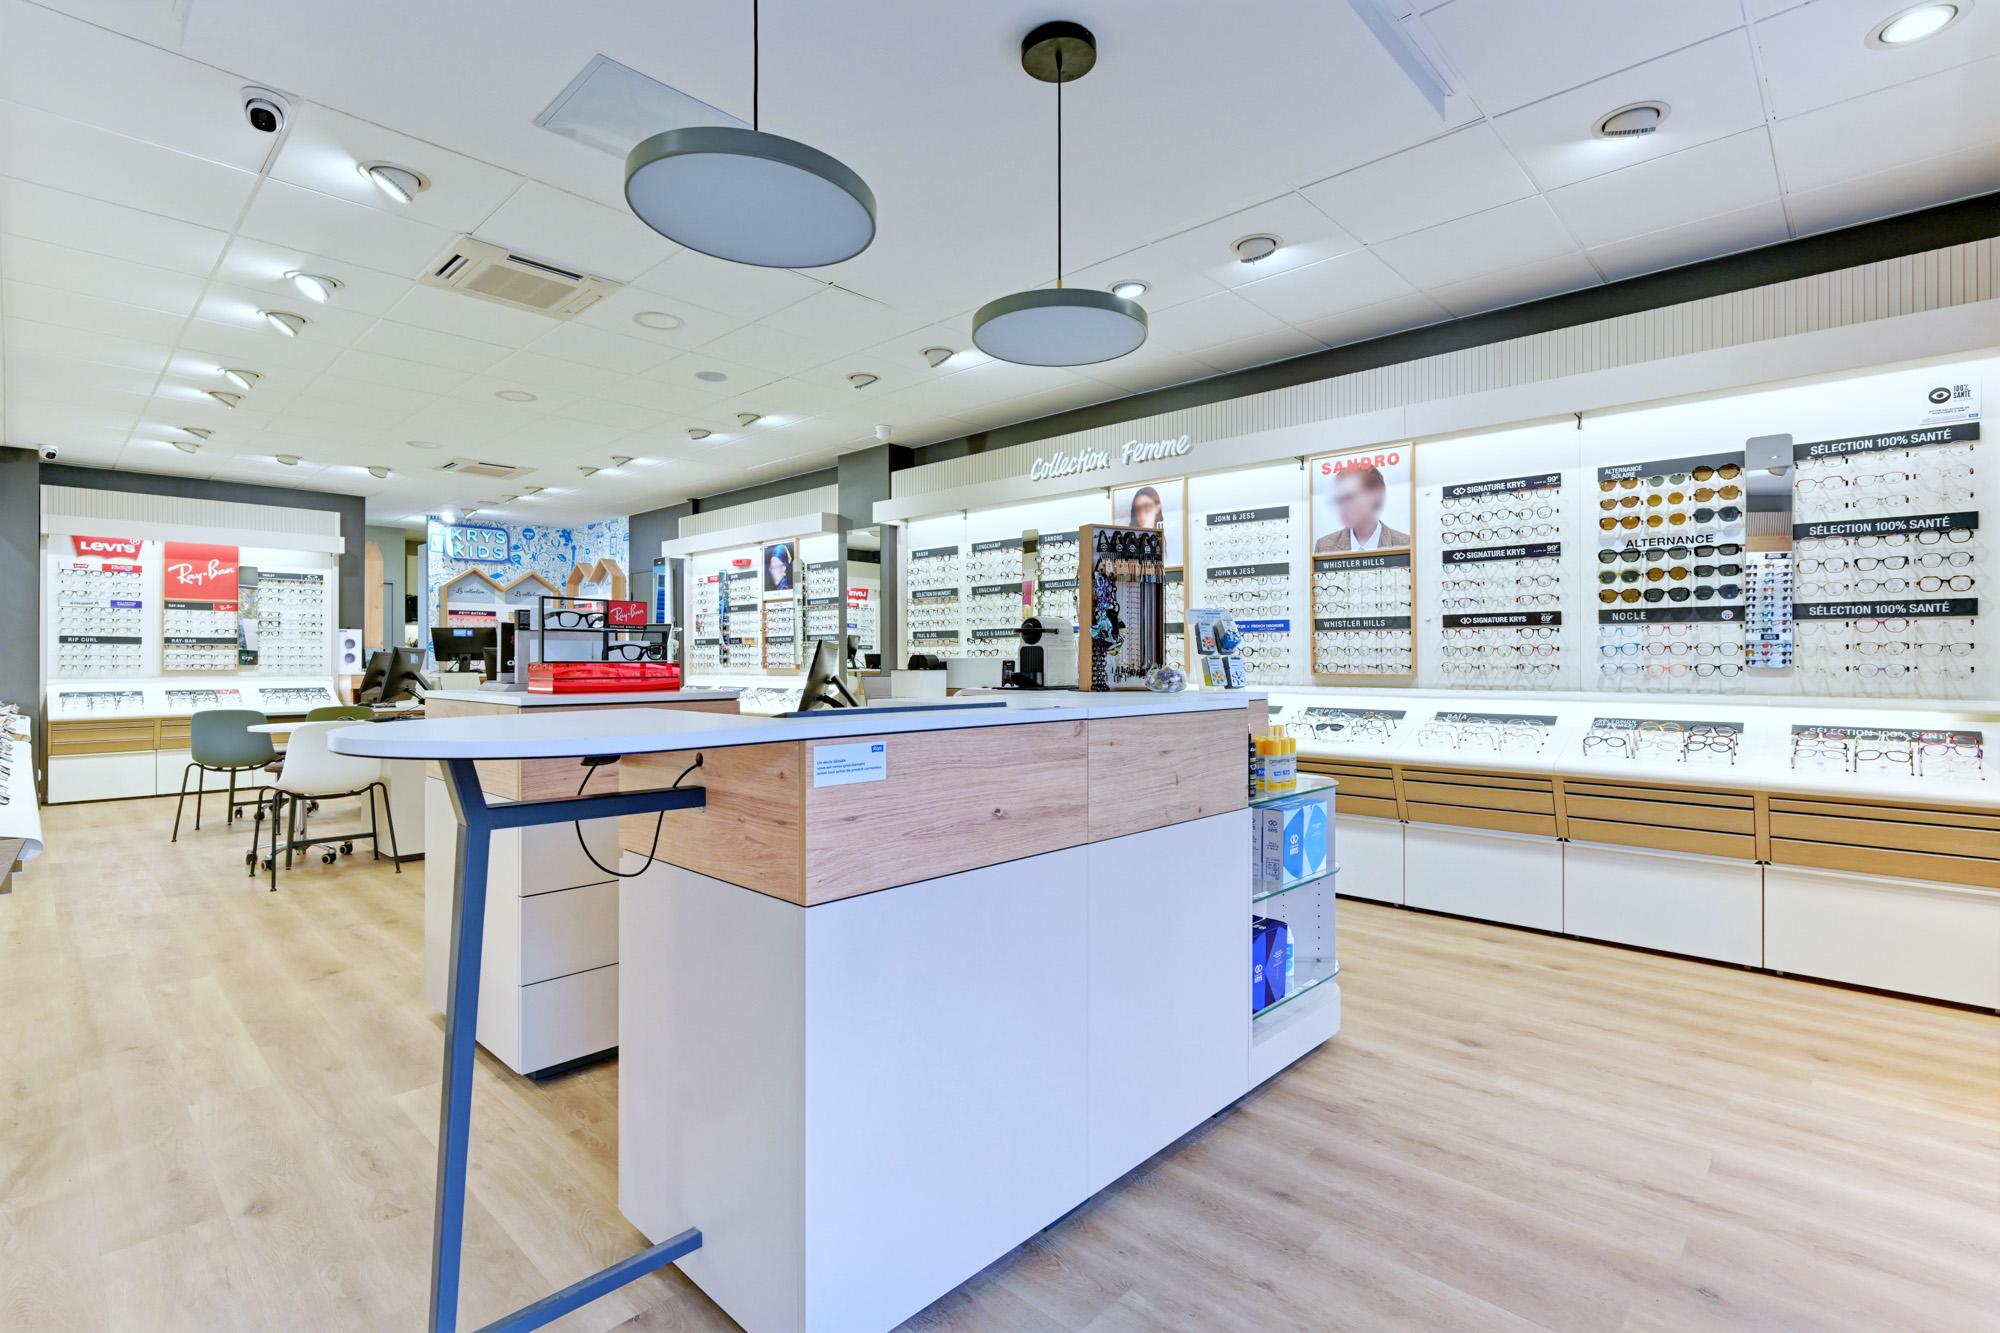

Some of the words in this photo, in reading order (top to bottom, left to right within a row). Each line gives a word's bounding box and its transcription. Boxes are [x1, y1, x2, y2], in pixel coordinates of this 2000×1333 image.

[1810, 438, 1873, 455] SÉLECTION
[1876, 434, 1908, 448] 100%
[1911, 428, 1952, 442] SANTÉ
[1031, 447, 1110, 481] Collection
[1122, 434, 1191, 465] Femme
[1321, 452, 1400, 475] SANDRO
[1604, 465, 1642, 475] ALTERNANCE
[1611, 472, 1636, 480] SOLAIRE
[1466, 482, 1506, 494] SIGNATURE
[1507, 480, 1526, 489] KRYS
[1214, 514, 1231, 523] JOHN
[1239, 511, 1255, 520] JESS
[1809, 522, 1872, 536] SÉLECTION
[1875, 518, 1907, 531] 100%
[1909, 515, 1950, 529] SANTÉ
[450, 528, 506, 544] KRYS
[1625, 533, 1714, 548] ALTERNANCE
[453, 544, 504, 559] KIDS
[976, 541, 1001, 551] LONGCHAMP
[1466, 549, 1506, 559] SIGNATURE
[1507, 548, 1526, 556] KRYS
[1323, 559, 1360, 569] WHISTLER
[1363, 558, 1385, 567] HILLS
[167, 559, 236, 586] Ray-Ban
[1214, 569, 1231, 577] JOHN
[1239, 567, 1255, 575] JESS
[976, 586, 1001, 594] LONGCHAMP
[610, 603, 644, 622] Ray-Ban
[1809, 603, 1872, 616] SÉLECTION
[1875, 602, 1906, 614] 100%
[1909, 601, 1950, 613] SANTÉ
[1472, 616, 1508, 624] SIGNATURE
[1509, 615, 1527, 623] KRYS
[1612, 611, 1647, 621] NOCLE
[1324, 620, 1361, 628] WHISTLER
[1363, 619, 1386, 627] HILLS
[1809, 727, 1874, 737] SÉLECTION
